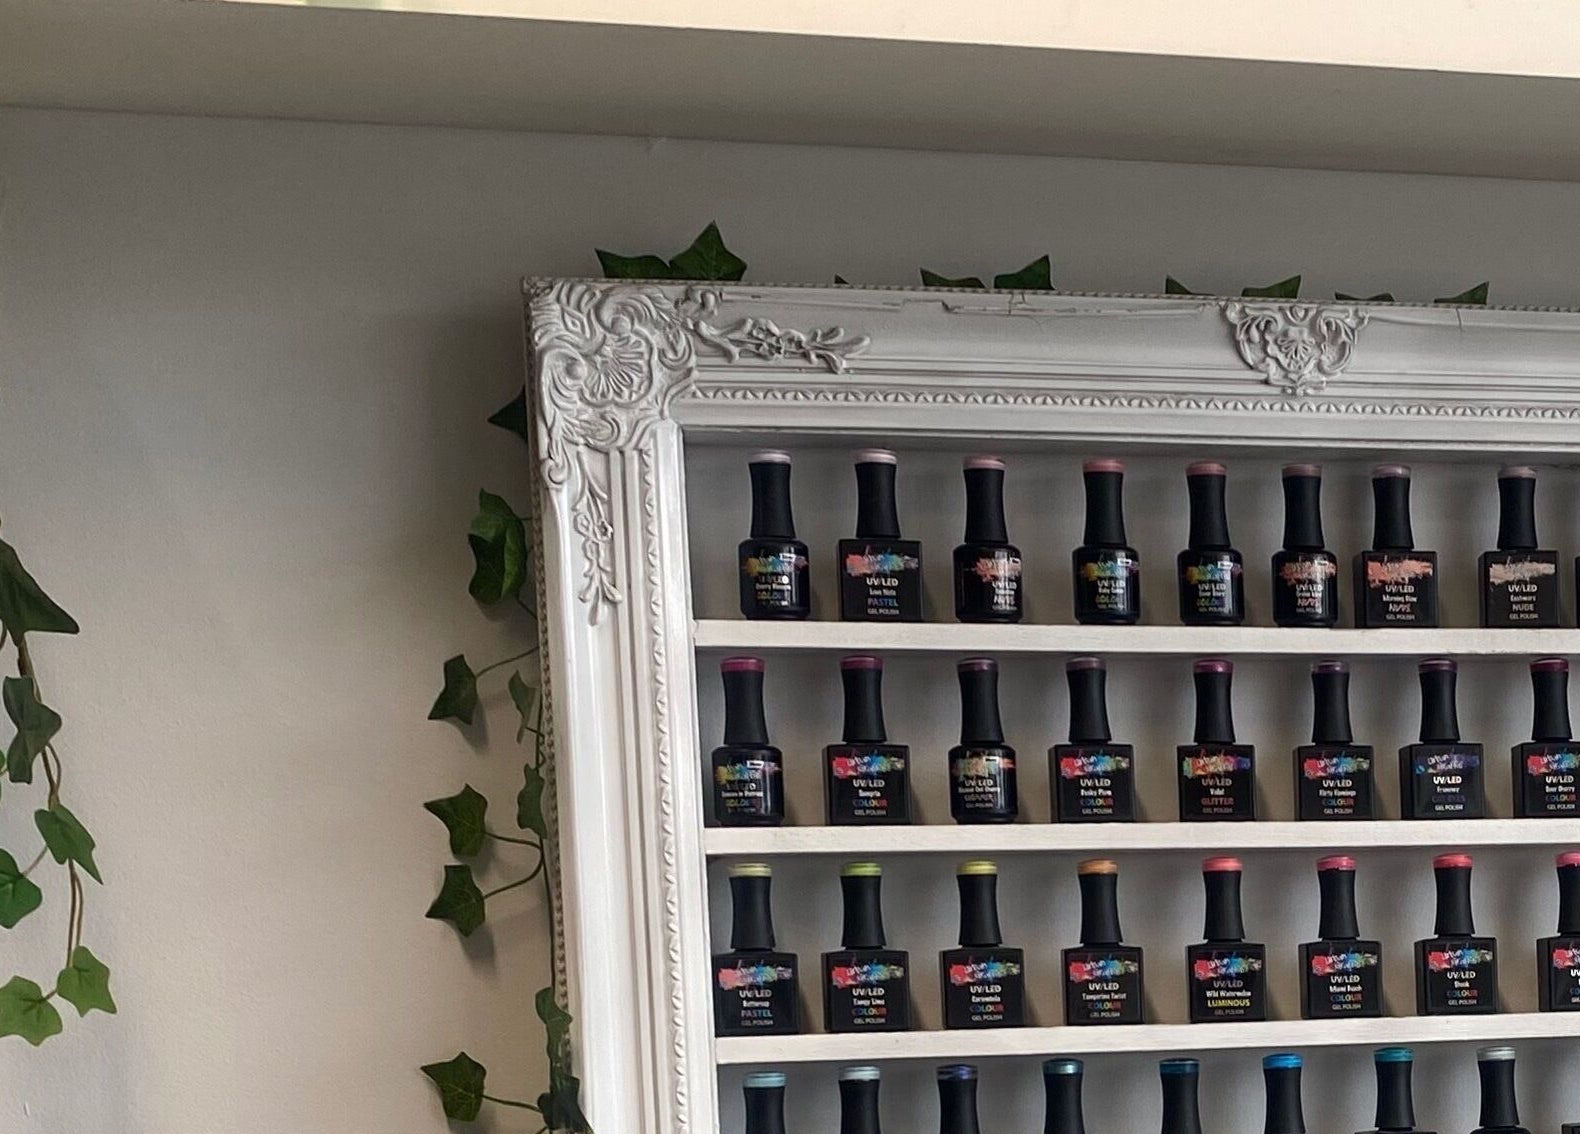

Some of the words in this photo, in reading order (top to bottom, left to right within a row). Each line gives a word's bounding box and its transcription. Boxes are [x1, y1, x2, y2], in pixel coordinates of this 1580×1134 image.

[1507, 584, 1538, 594] UV/LED
[867, 598, 899, 607] PASTEL
[1322, 779, 1352, 788] UV/LED
[1433, 776, 1462, 785] UV/LED
[1545, 776, 1574, 785] UV/LED
[852, 799, 888, 808] COLOUR
[1447, 971, 1476, 980] UV/LED
[1330, 976, 1360, 985] UV/LED
[1207, 999, 1250, 1008] LUMINOUS
[852, 1008, 887, 1017] COLOUR
[970, 1004, 1004, 1013] COLOUR
[741, 1009, 773, 1018] PASTEL
